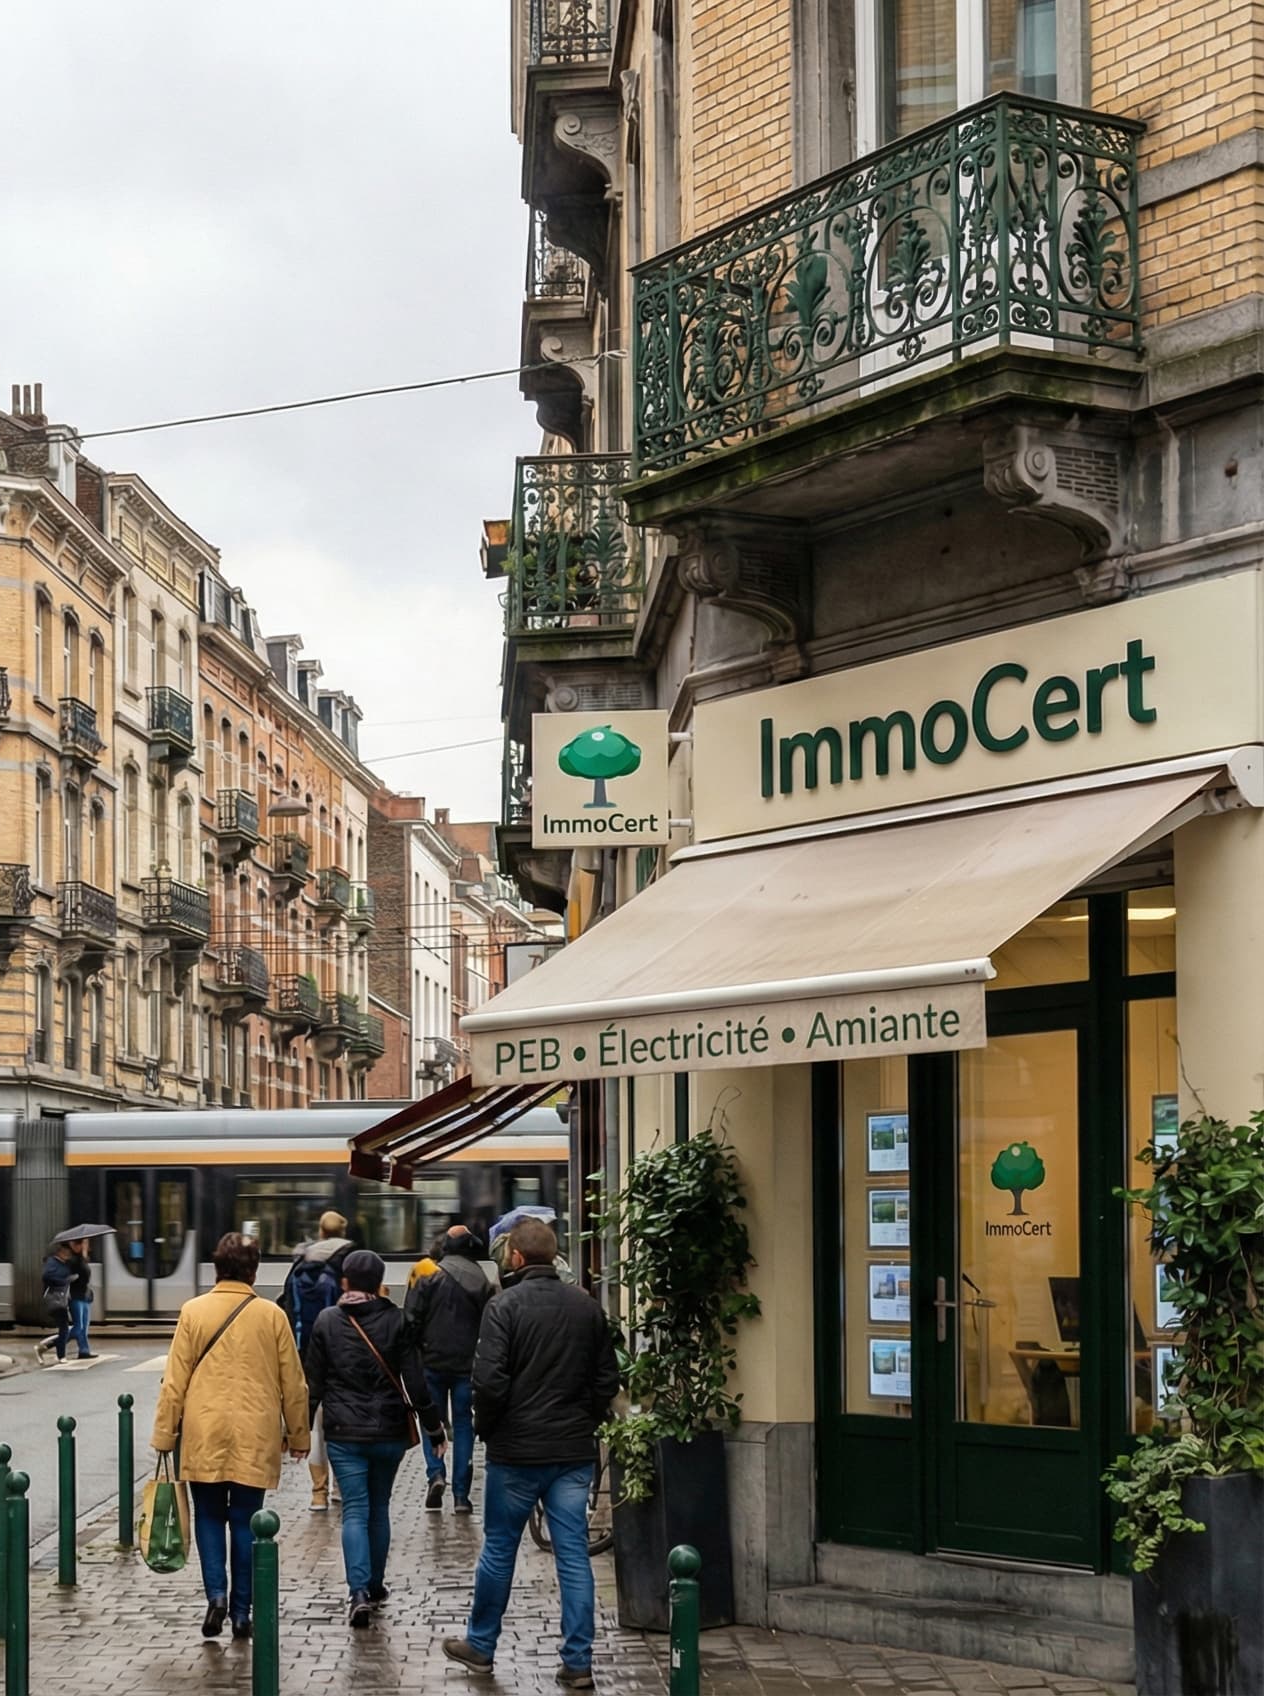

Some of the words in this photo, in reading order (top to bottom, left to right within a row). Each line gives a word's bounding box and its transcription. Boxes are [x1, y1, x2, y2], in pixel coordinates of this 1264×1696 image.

[760, 638, 1158, 799] ImmoCert
[543, 813, 659, 834] ImmoCert
[495, 1037, 561, 1076] PEB
[598, 1015, 770, 1067] Électricité
[805, 1002, 961, 1049] Amiante
[985, 1220, 1053, 1237] ImmoCert
